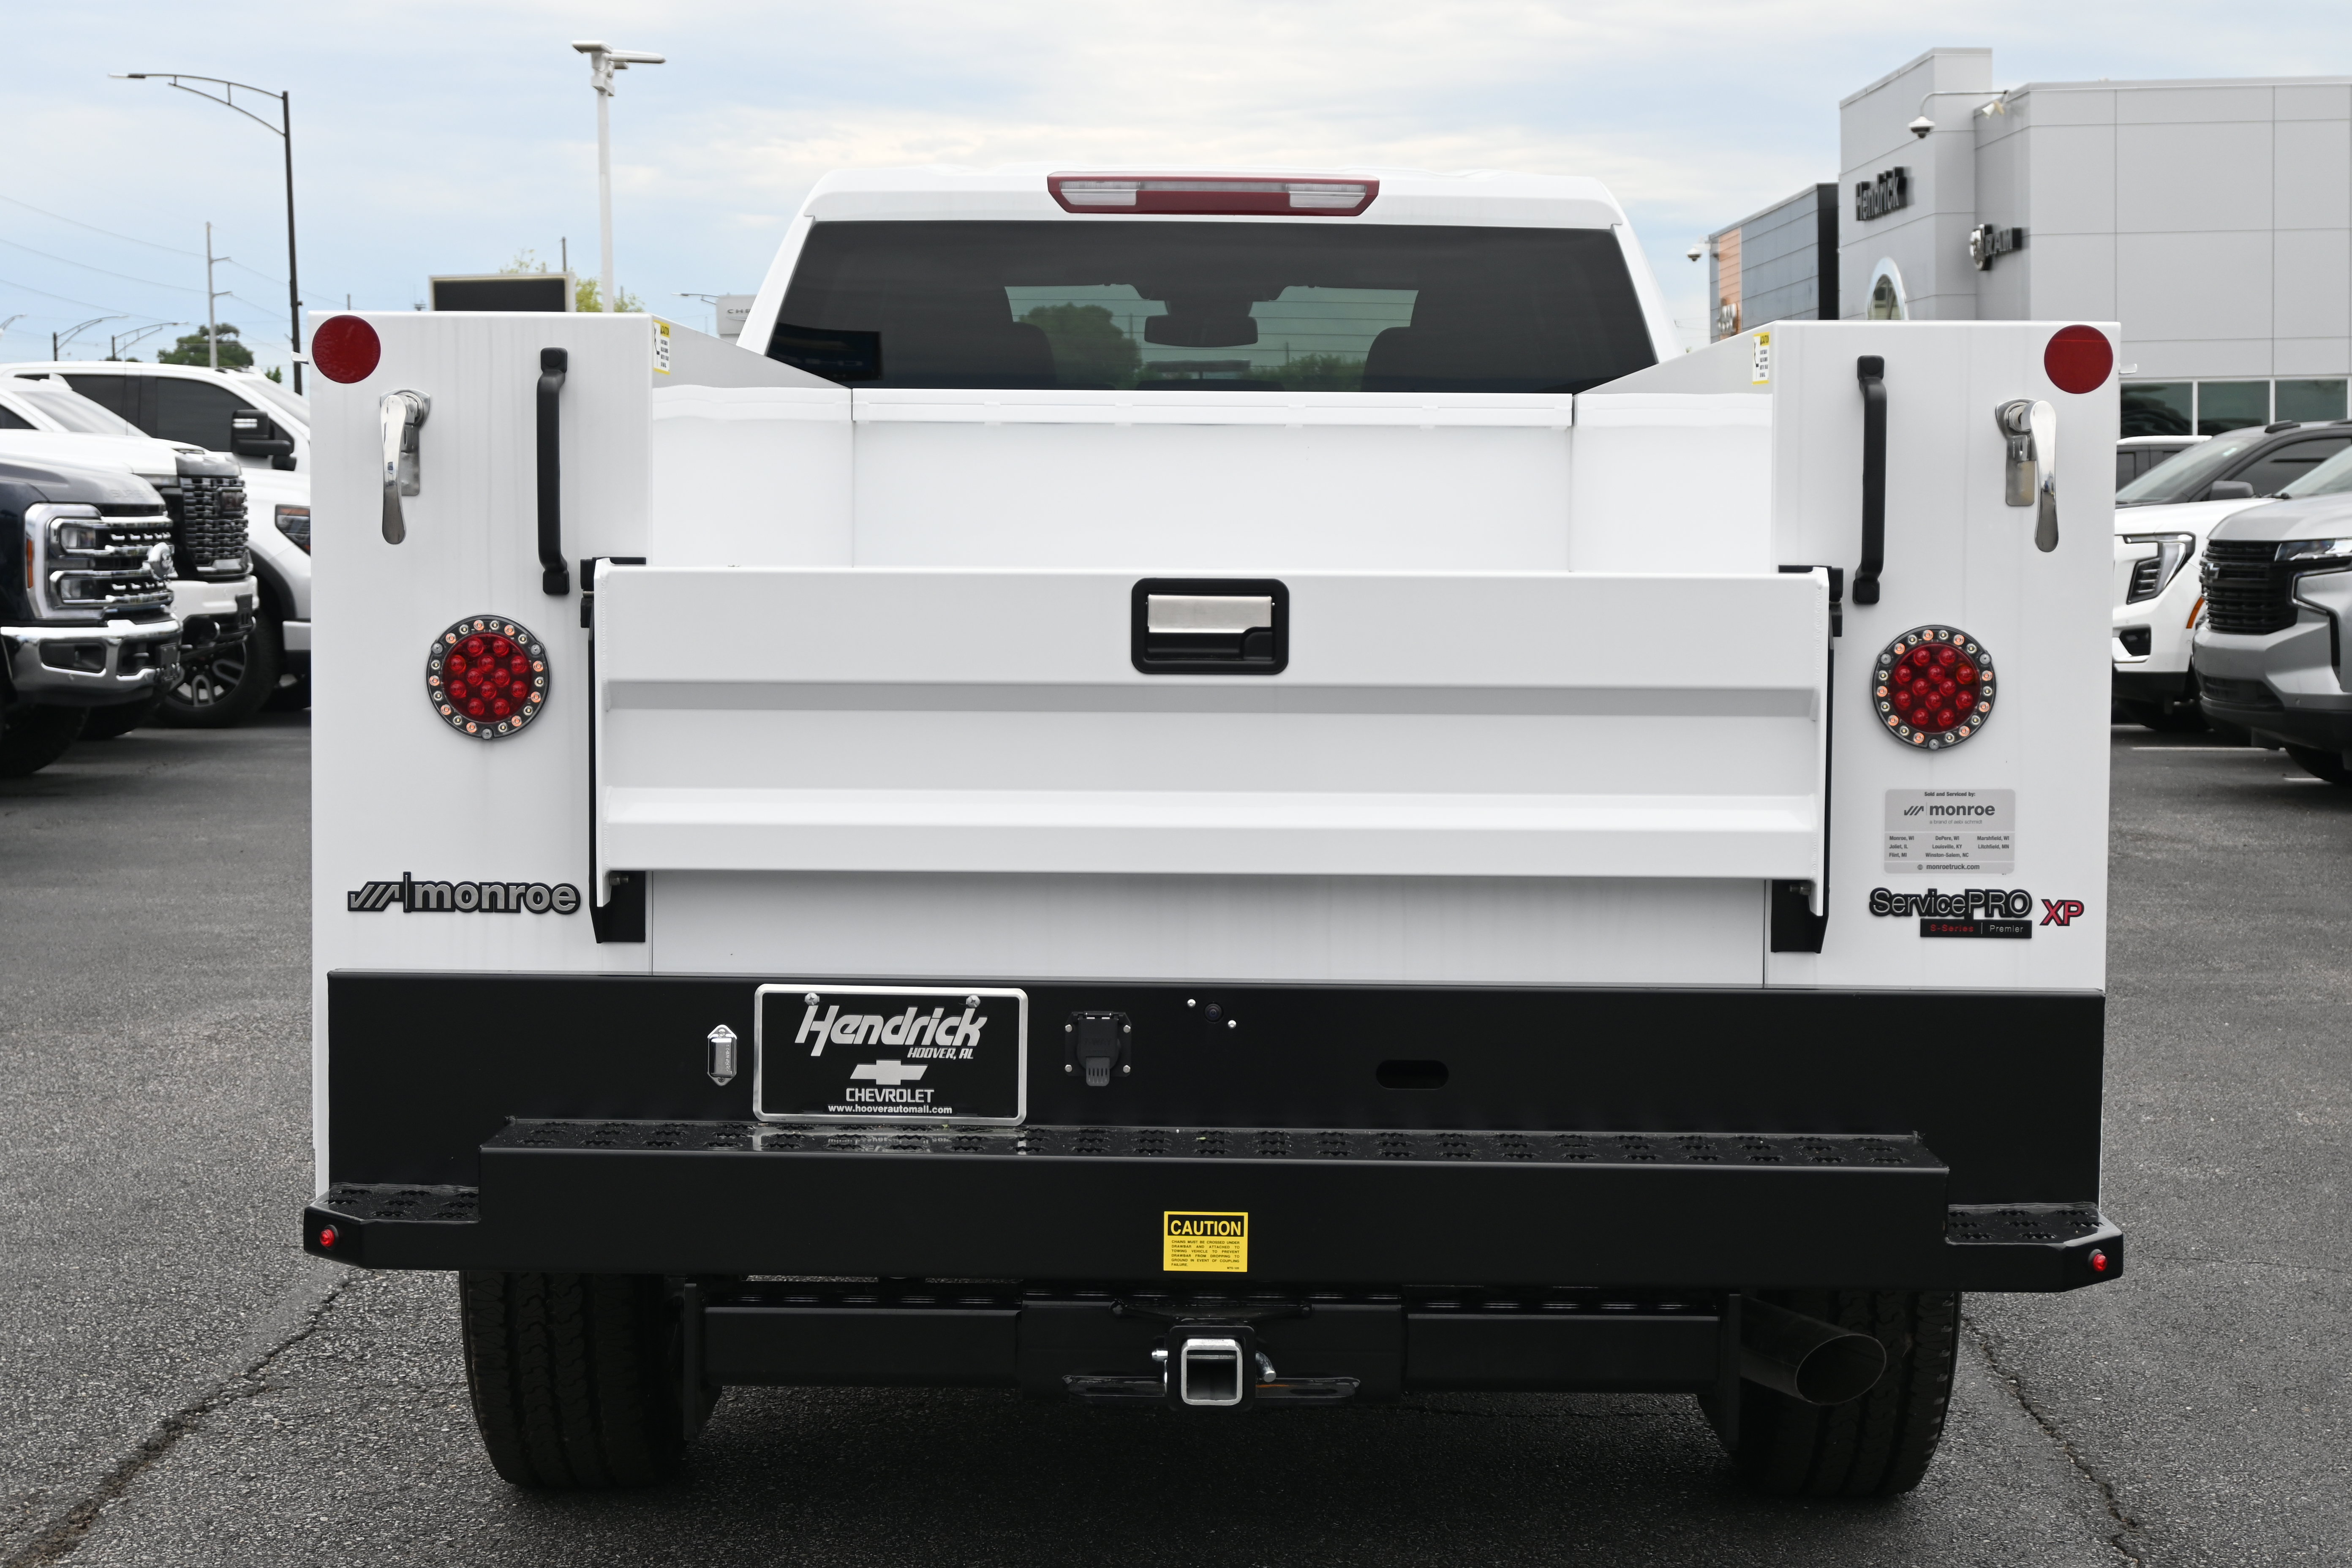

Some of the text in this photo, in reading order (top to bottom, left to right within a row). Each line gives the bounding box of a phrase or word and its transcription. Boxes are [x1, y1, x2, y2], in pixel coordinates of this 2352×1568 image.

[1856, 166, 1907, 220] Hendrick
[1985, 227, 2022, 256] RAM
[1930, 805, 1995, 816] monroe
[413, 882, 580, 914] monroe
[1870, 888, 2085, 926] ServicePRO XP
[1930, 924, 2024, 933] S-Series Premier
[795, 1004, 988, 1056] Hendrick
[907, 1047, 974, 1059] HOOVER, AL
[846, 1088, 934, 1103] CHEVROLET
[828, 1104, 953, 1114] www.hooverautomall.com
[1171, 1220, 1241, 1236] CAUTION
